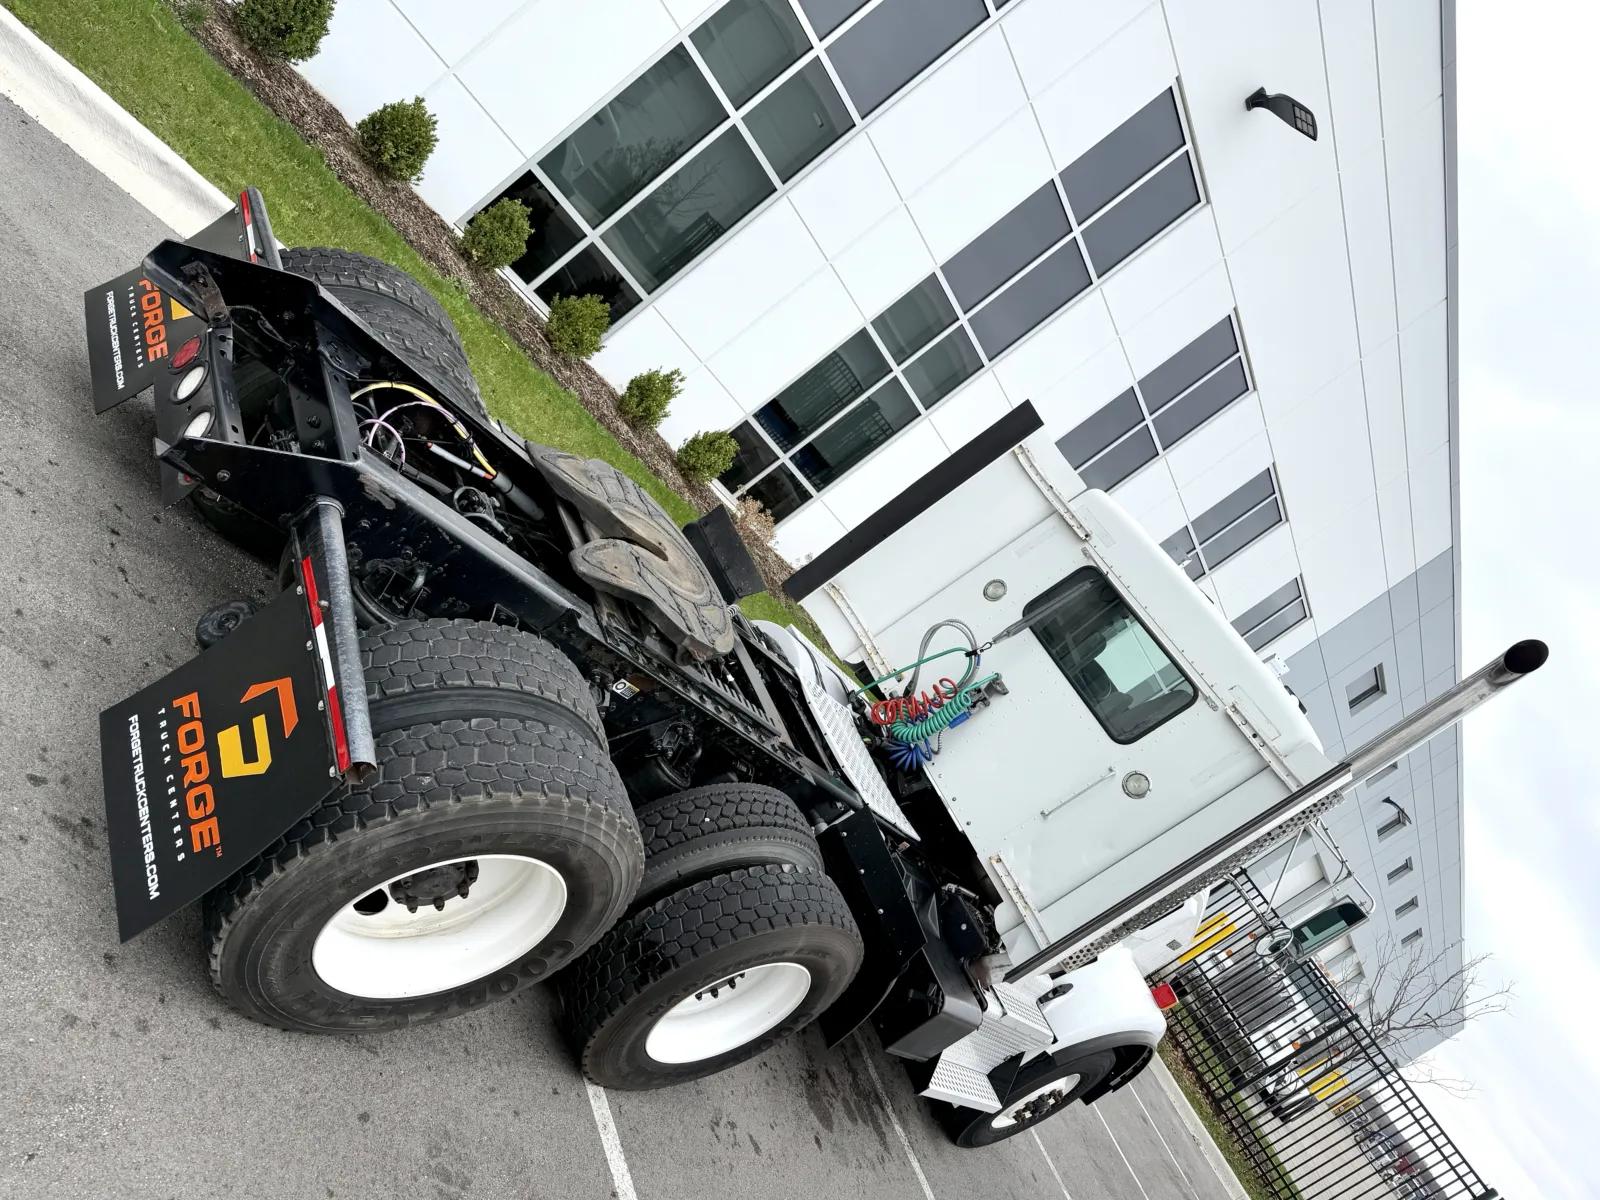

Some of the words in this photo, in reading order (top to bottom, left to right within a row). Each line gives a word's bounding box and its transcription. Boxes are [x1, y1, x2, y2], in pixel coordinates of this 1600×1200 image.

[106, 290, 125, 390] FORGETRUCKCENTERS.COM
[128, 286, 137, 318] TRUCK
[132, 322, 144, 368] CENTERS
[128, 714, 160, 900] FORGETRUCKCENTERS.COM
[158, 707, 172, 764] TRUCK
[166, 774, 185, 862] CENTERS
[173, 691, 221, 853] FORGE
